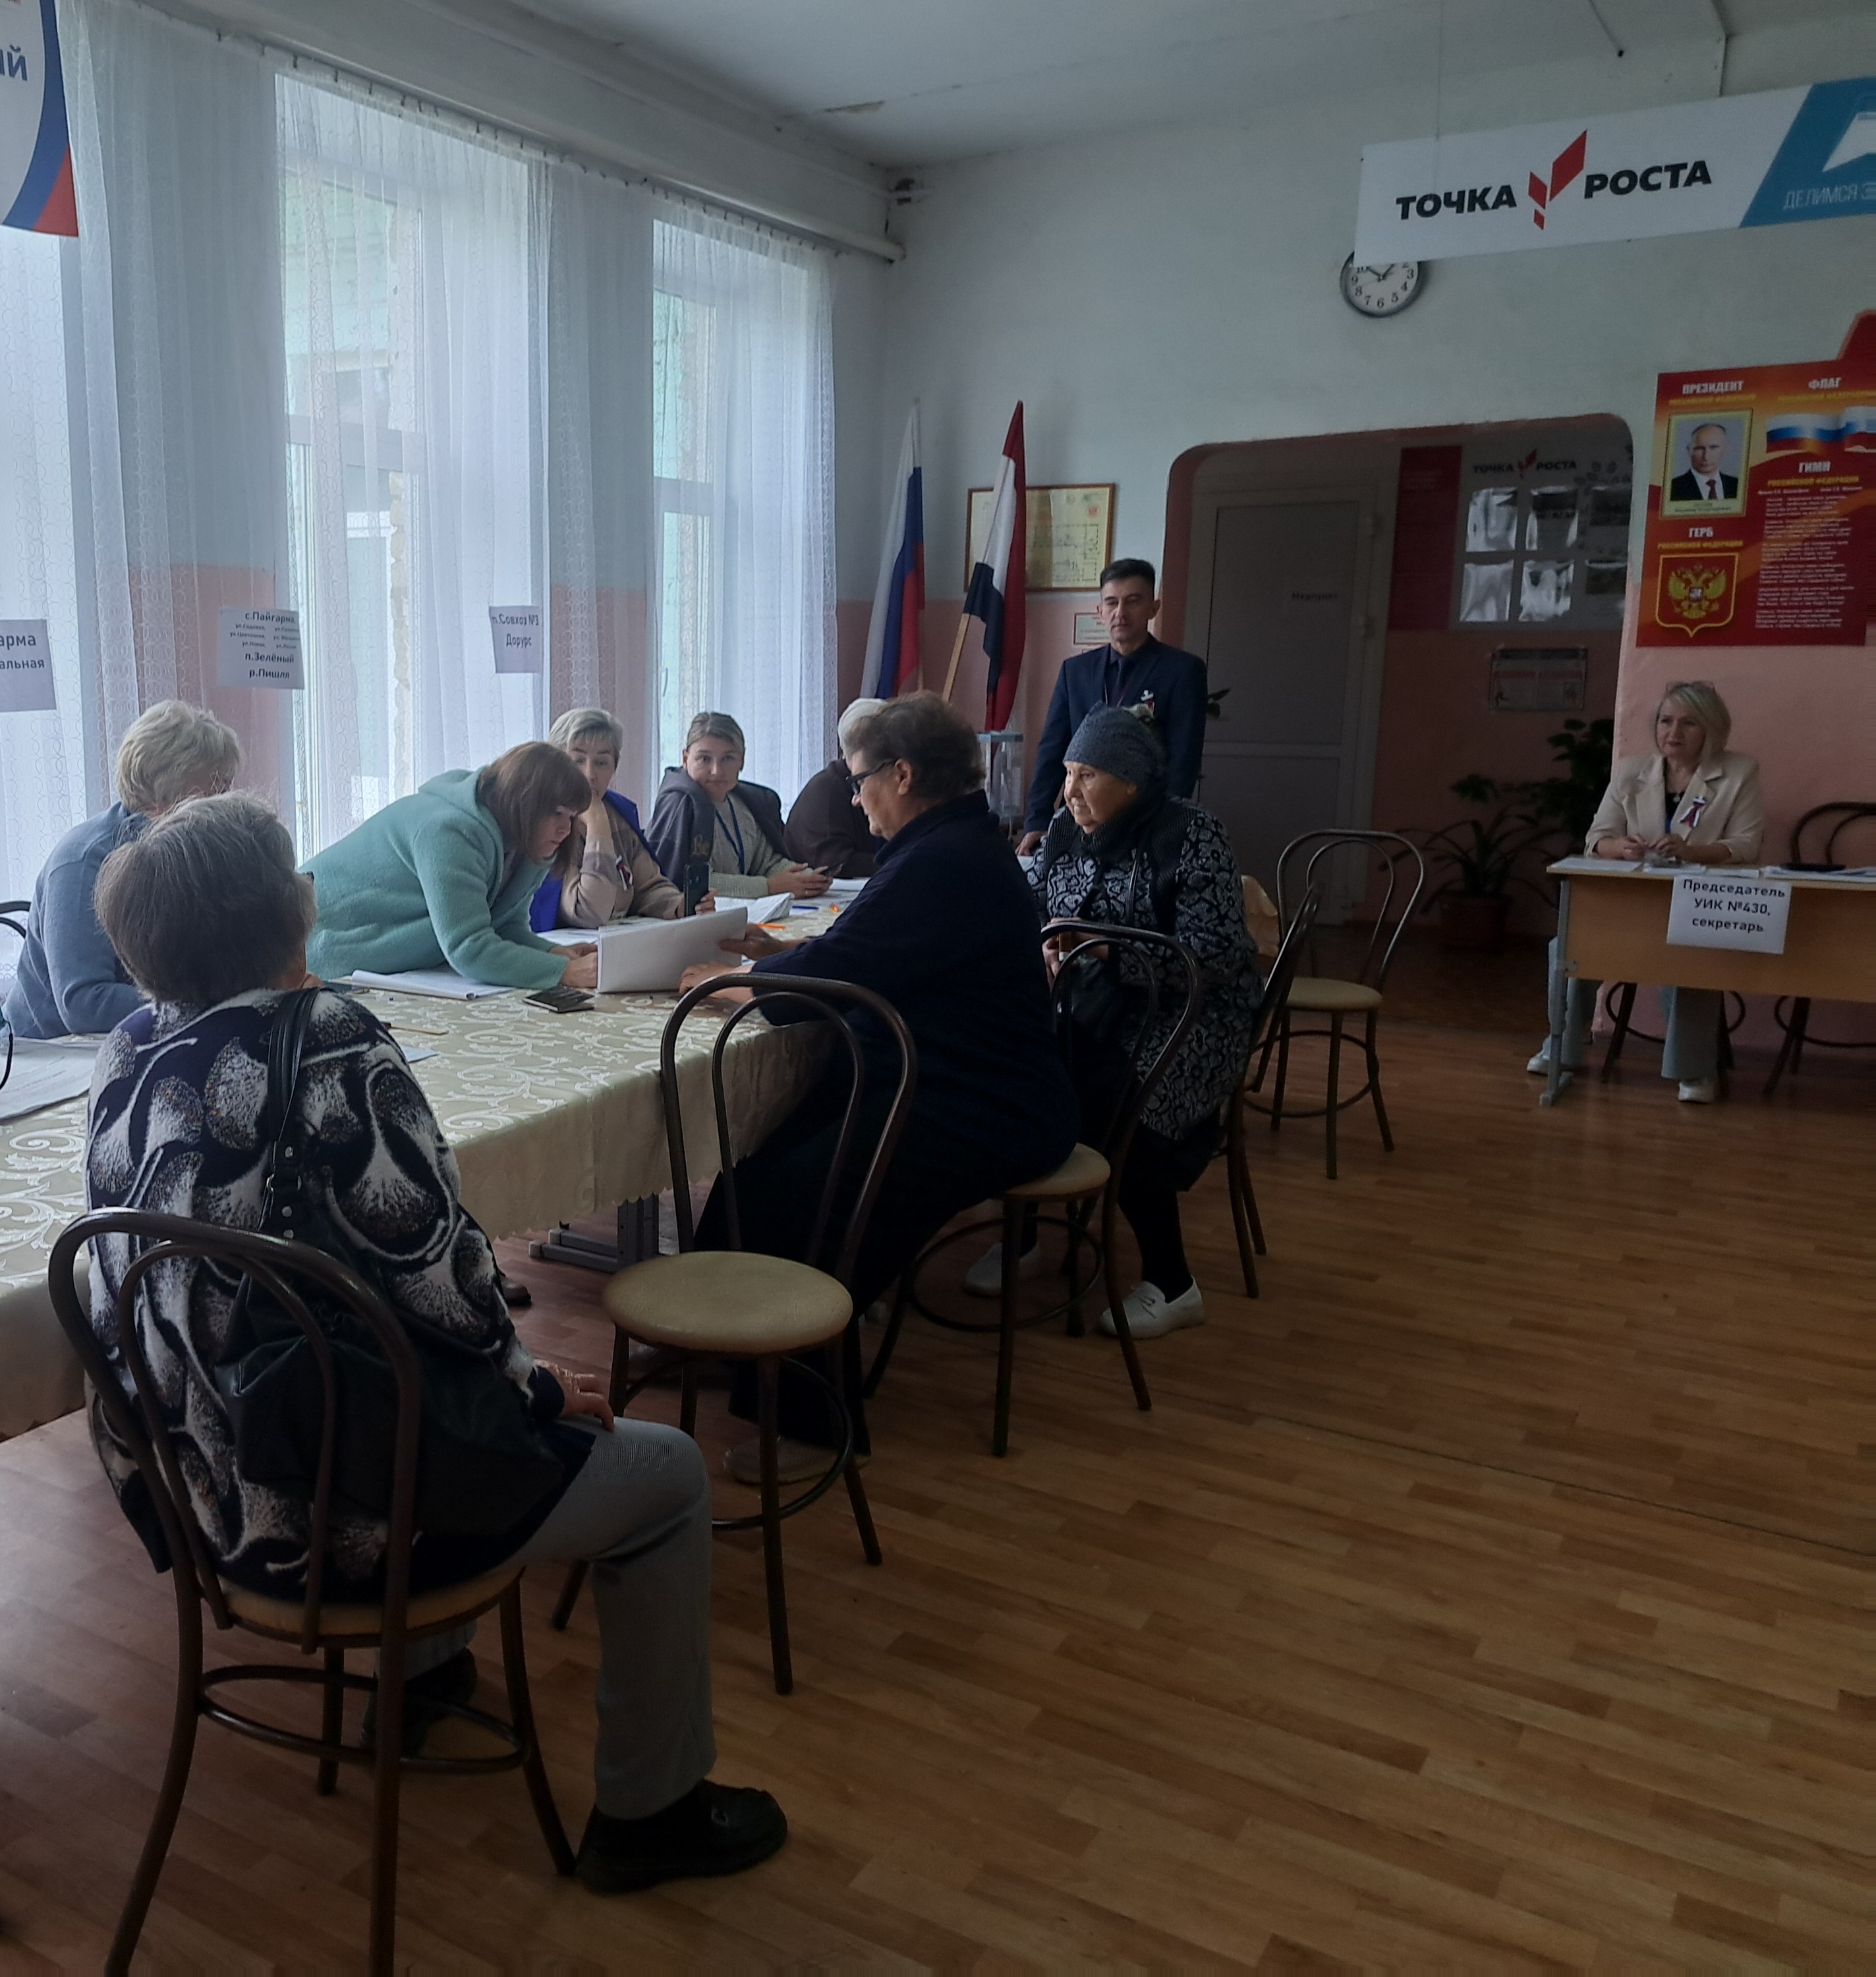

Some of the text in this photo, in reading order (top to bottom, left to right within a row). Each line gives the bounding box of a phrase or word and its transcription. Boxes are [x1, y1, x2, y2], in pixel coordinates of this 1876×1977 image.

[1396, 159, 1712, 220] ТОЧКА РОСТА
[1782, 183, 1858, 210] ДЕЛИМСЯ
[1407, 268, 1413, 279] 3
[1351, 275, 1359, 286] 9
[1400, 281, 1407, 291] 4
[1355, 286, 1362, 296] 8
[1365, 295, 1372, 306] 7
[1391, 292, 1398, 302] 5
[1377, 298, 1384, 308] 6
[1682, 380, 1744, 395] ПРЕЗИДЕНТ
[1808, 377, 1842, 389] ФЛАГ
[1473, 461, 1577, 474] ТОЧКА РОСТА
[1798, 461, 1831, 473] ГИМН
[1689, 527, 1714, 538] ГЕРБ
[245, 652, 295, 663] п.Зелёный
[1683, 878, 1785, 898] Председатель
[1694, 898, 1722, 911] УИК
[1692, 917, 1763, 934] секретарь
